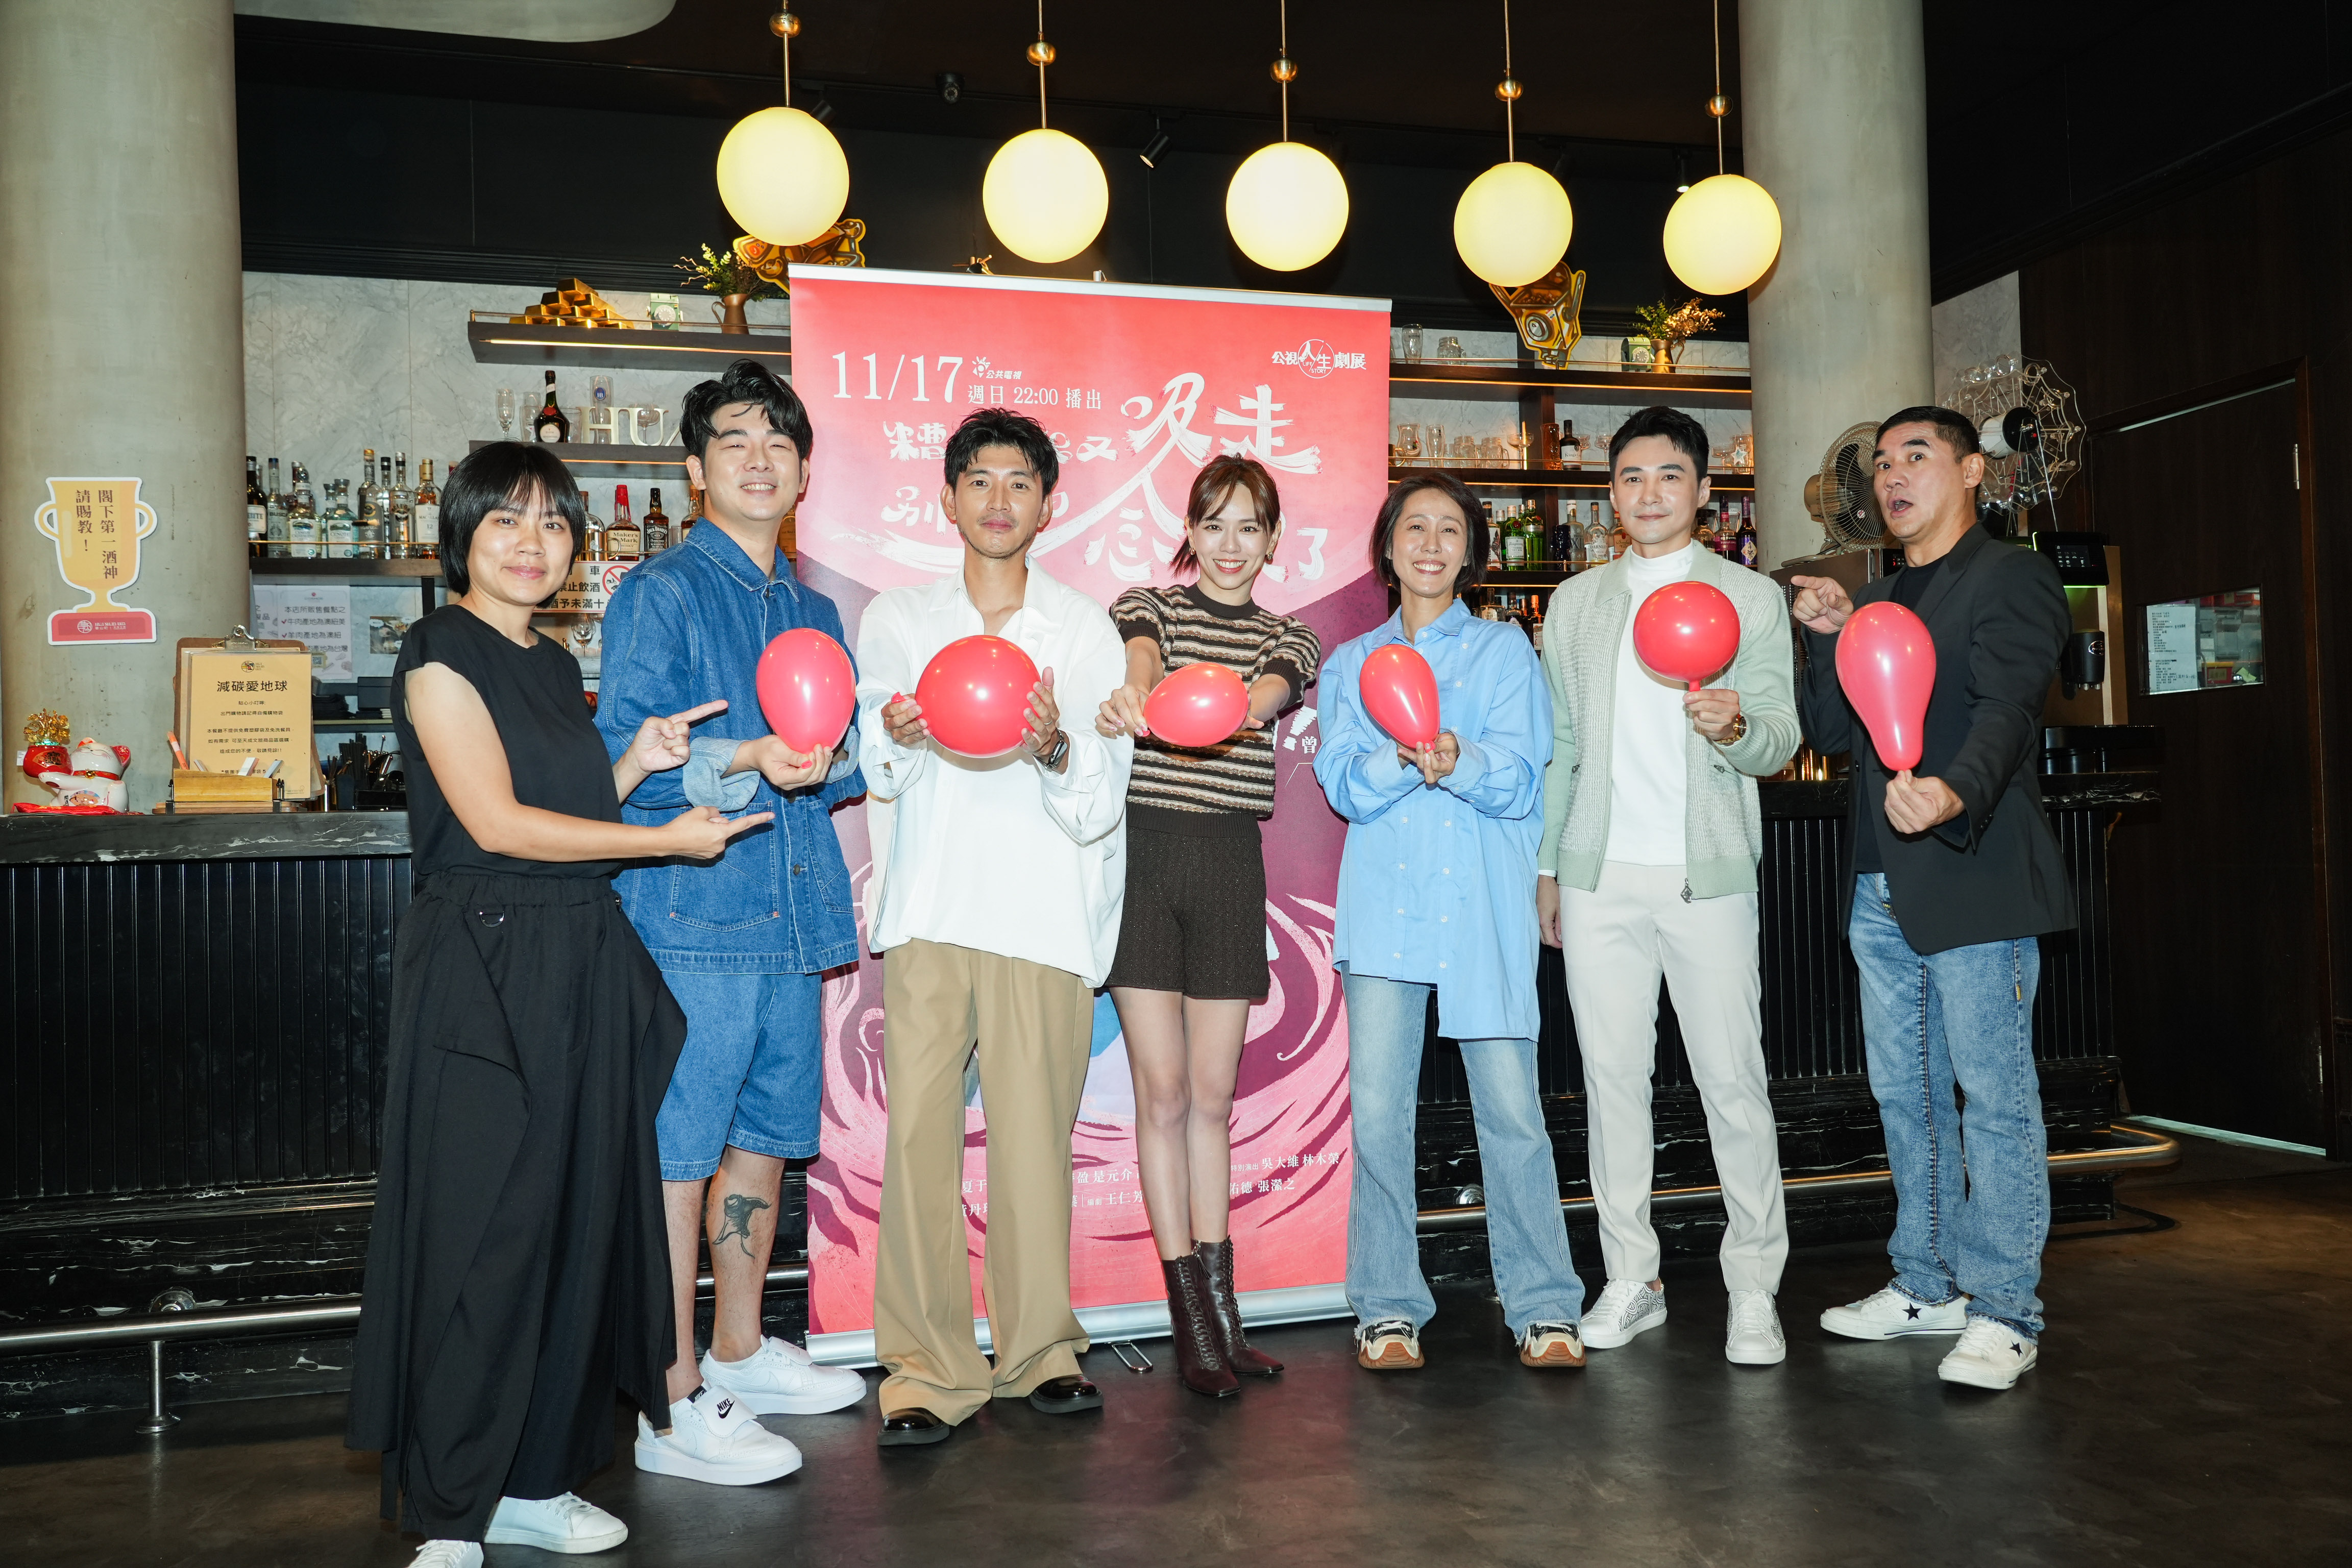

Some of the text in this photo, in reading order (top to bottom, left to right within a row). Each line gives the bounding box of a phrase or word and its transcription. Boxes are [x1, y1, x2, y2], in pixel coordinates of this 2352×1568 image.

[832, 351, 963, 403] 11/17
[986, 370, 1022, 380] 公共電視
[968, 384, 1101, 409] 週日 22:00 播出
[98, 489, 118, 579] 閣下第一酒神
[551, 598, 610, 609] 酒予未滿十
[216, 680, 288, 692] 減碳愛地球
[1231, 1152, 1339, 1172] 特別演出 吳大維 林木榮
[1093, 1168, 1133, 1183] 是元介
[1087, 1198, 1102, 1206] 編劇
[717, 1398, 731, 1412] NIKE
